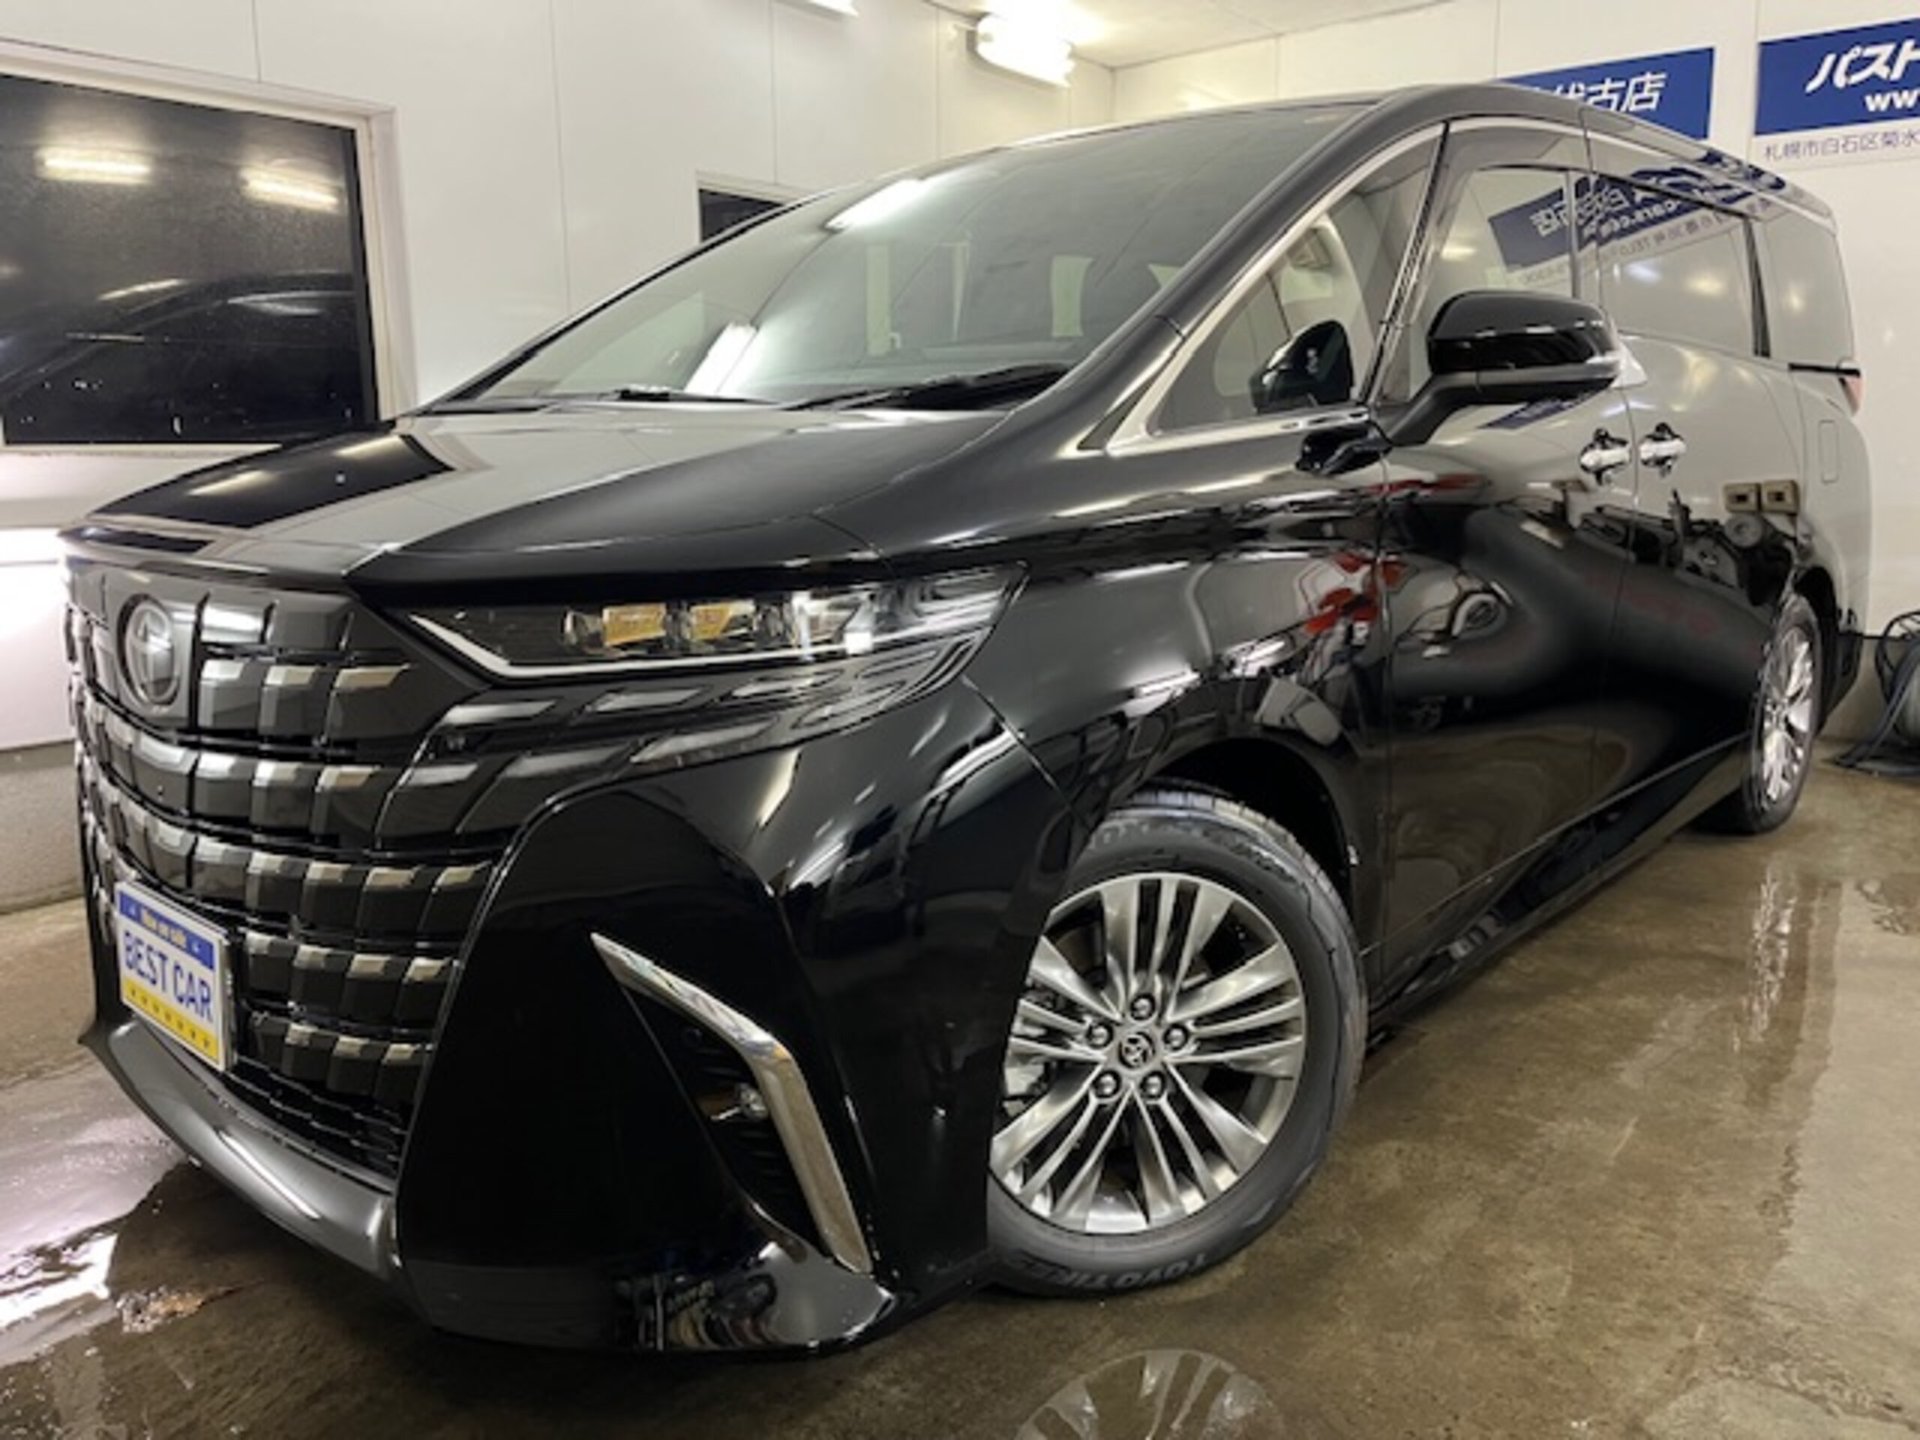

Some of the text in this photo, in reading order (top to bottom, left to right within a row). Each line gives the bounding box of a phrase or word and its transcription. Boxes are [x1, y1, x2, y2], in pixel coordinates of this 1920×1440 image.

[1804, 39, 1920, 93] パスト
[1864, 88, 1920, 112] ww
[123, 930, 214, 1023] BEST CAR
